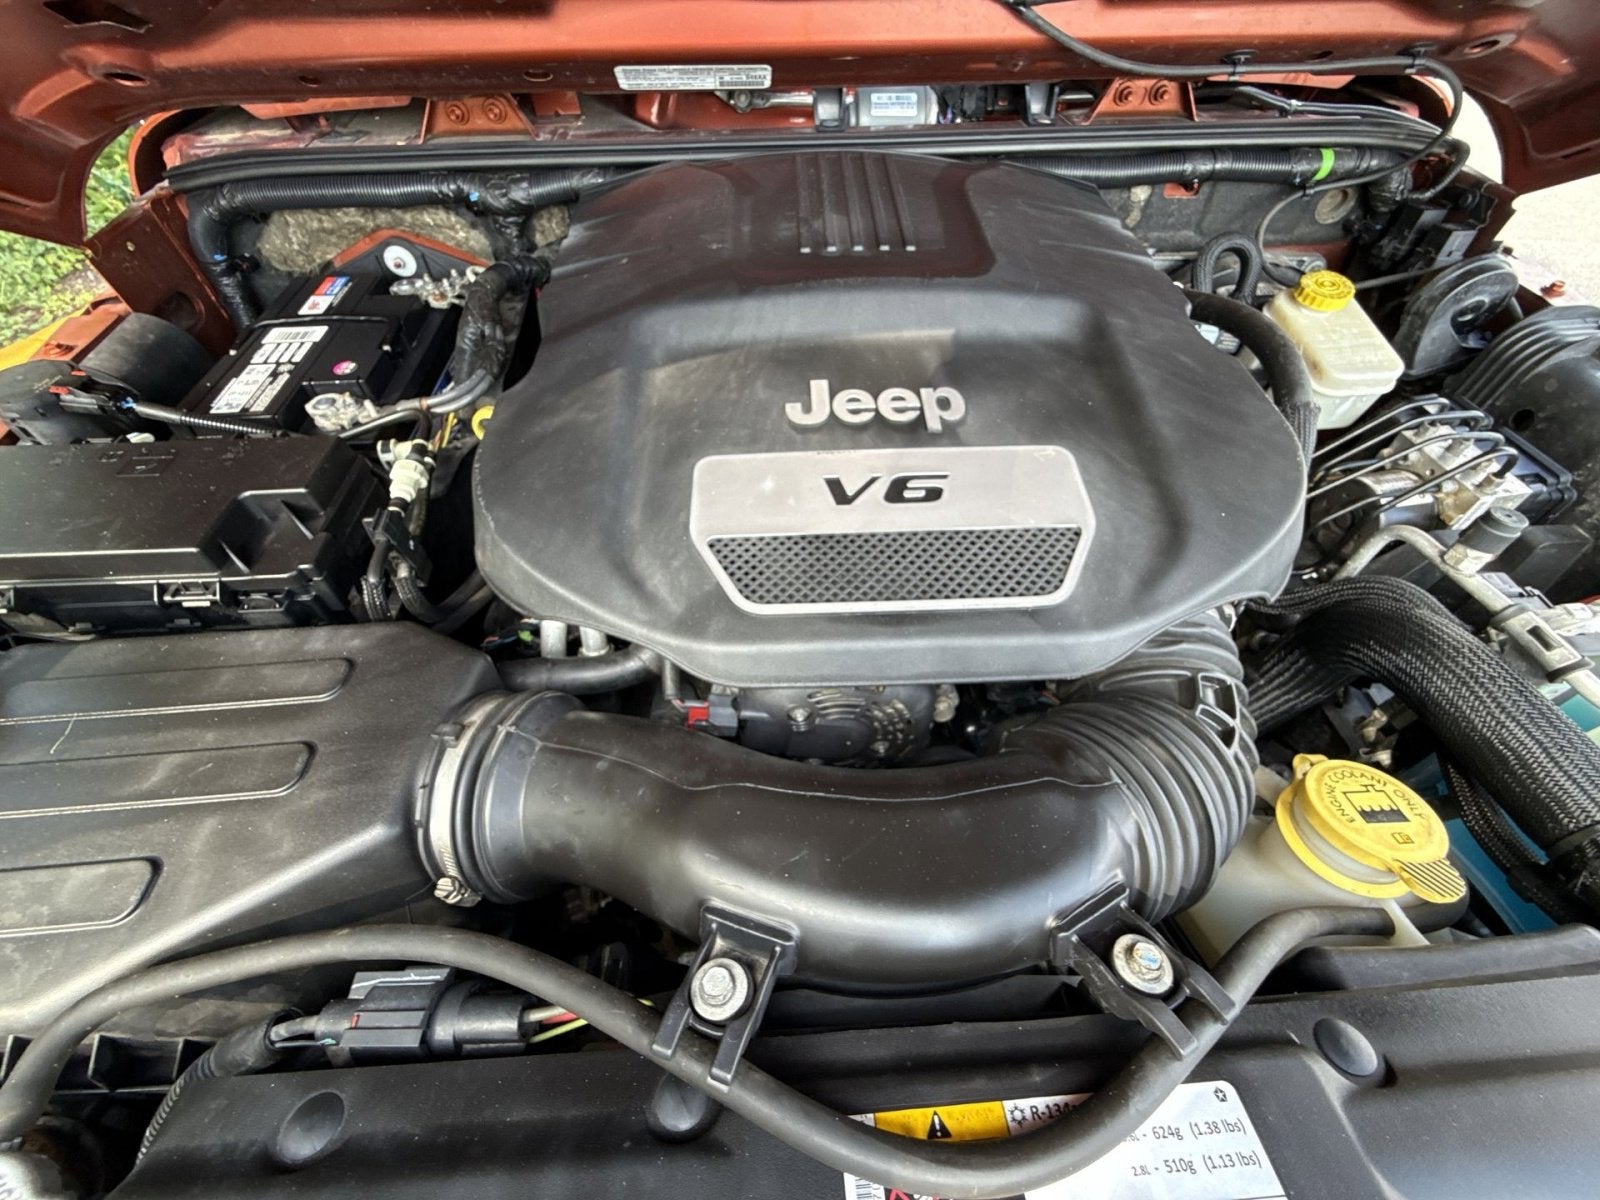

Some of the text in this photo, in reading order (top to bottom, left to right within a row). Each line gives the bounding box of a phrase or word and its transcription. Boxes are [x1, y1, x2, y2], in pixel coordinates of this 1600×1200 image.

[785, 379, 966, 433] Jeep
[823, 473, 951, 505] V6
[1324, 770, 1425, 823] ENGINE COOLANT ONLY
[1029, 1102, 1076, 1121] R-134
[1152, 1125, 1184, 1140] 624g
[1189, 1120, 1221, 1139] (1.38
[1221, 1117, 1247, 1135] lbs)
[1163, 1157, 1196, 1175] 510g
[1202, 1153, 1235, 1173] (1.13
[1235, 1150, 1262, 1169] lbs)
